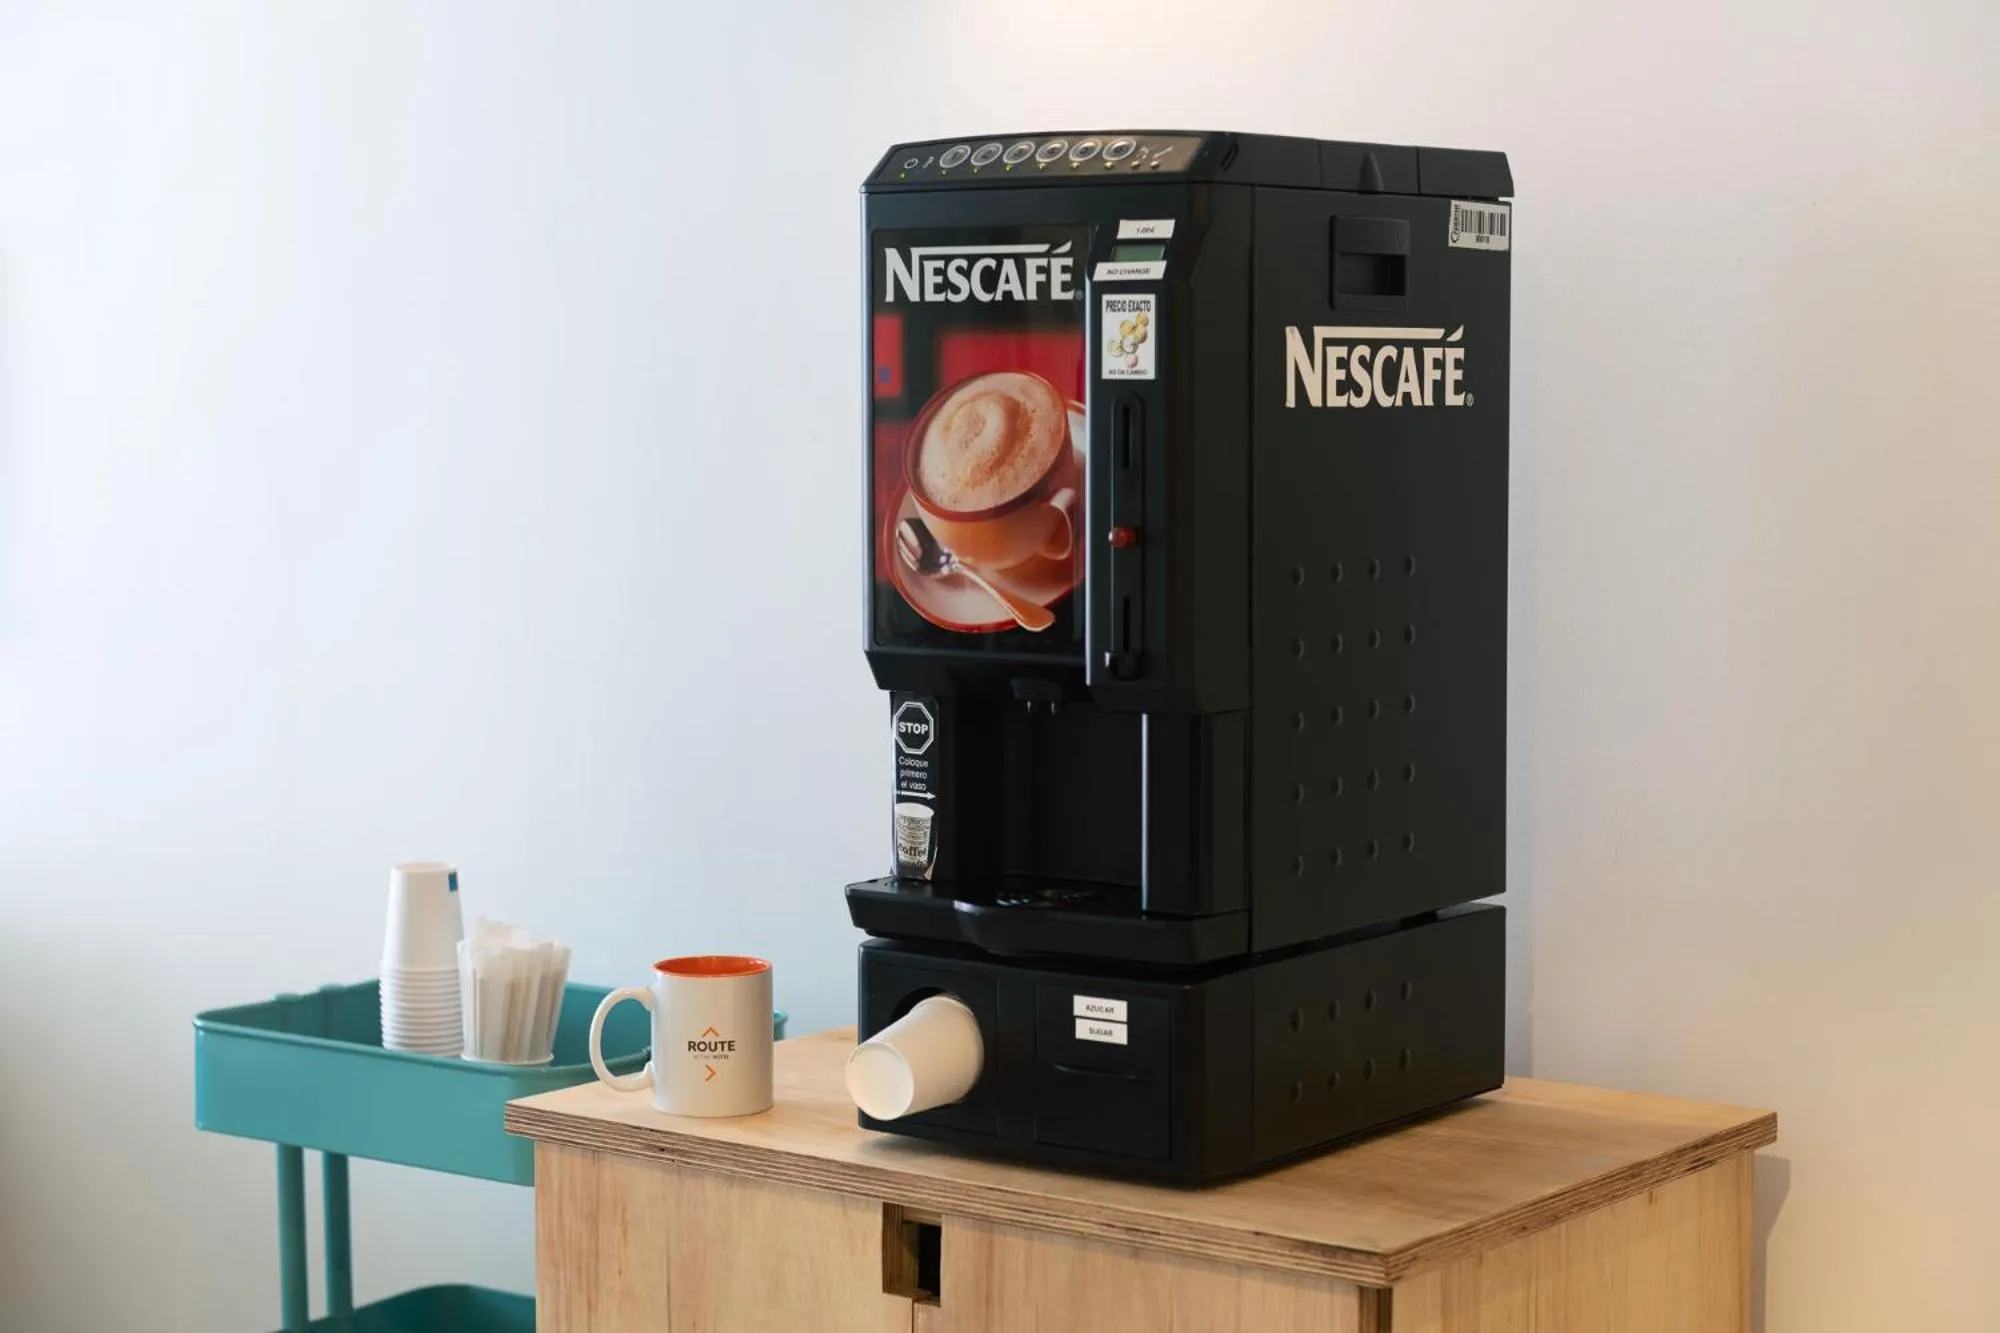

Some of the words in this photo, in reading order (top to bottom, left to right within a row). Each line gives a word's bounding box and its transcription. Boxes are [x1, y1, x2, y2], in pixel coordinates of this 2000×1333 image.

[885, 241, 1075, 303] NESCAFÉ
[1106, 268, 1118, 276] NO
[1105, 300, 1127, 313] PRECIO
[1128, 300, 1151, 313] EXACTO
[1285, 325, 1465, 408] NESCAFÉ
[899, 721, 929, 735] STOP
[898, 756, 928, 768] Coloque
[900, 770, 928, 780] primero
[900, 780, 908, 789] el
[909, 782, 927, 791] vaso
[1089, 1027, 1113, 1036] SUGAR
[687, 1040, 736, 1052] ROUTE
